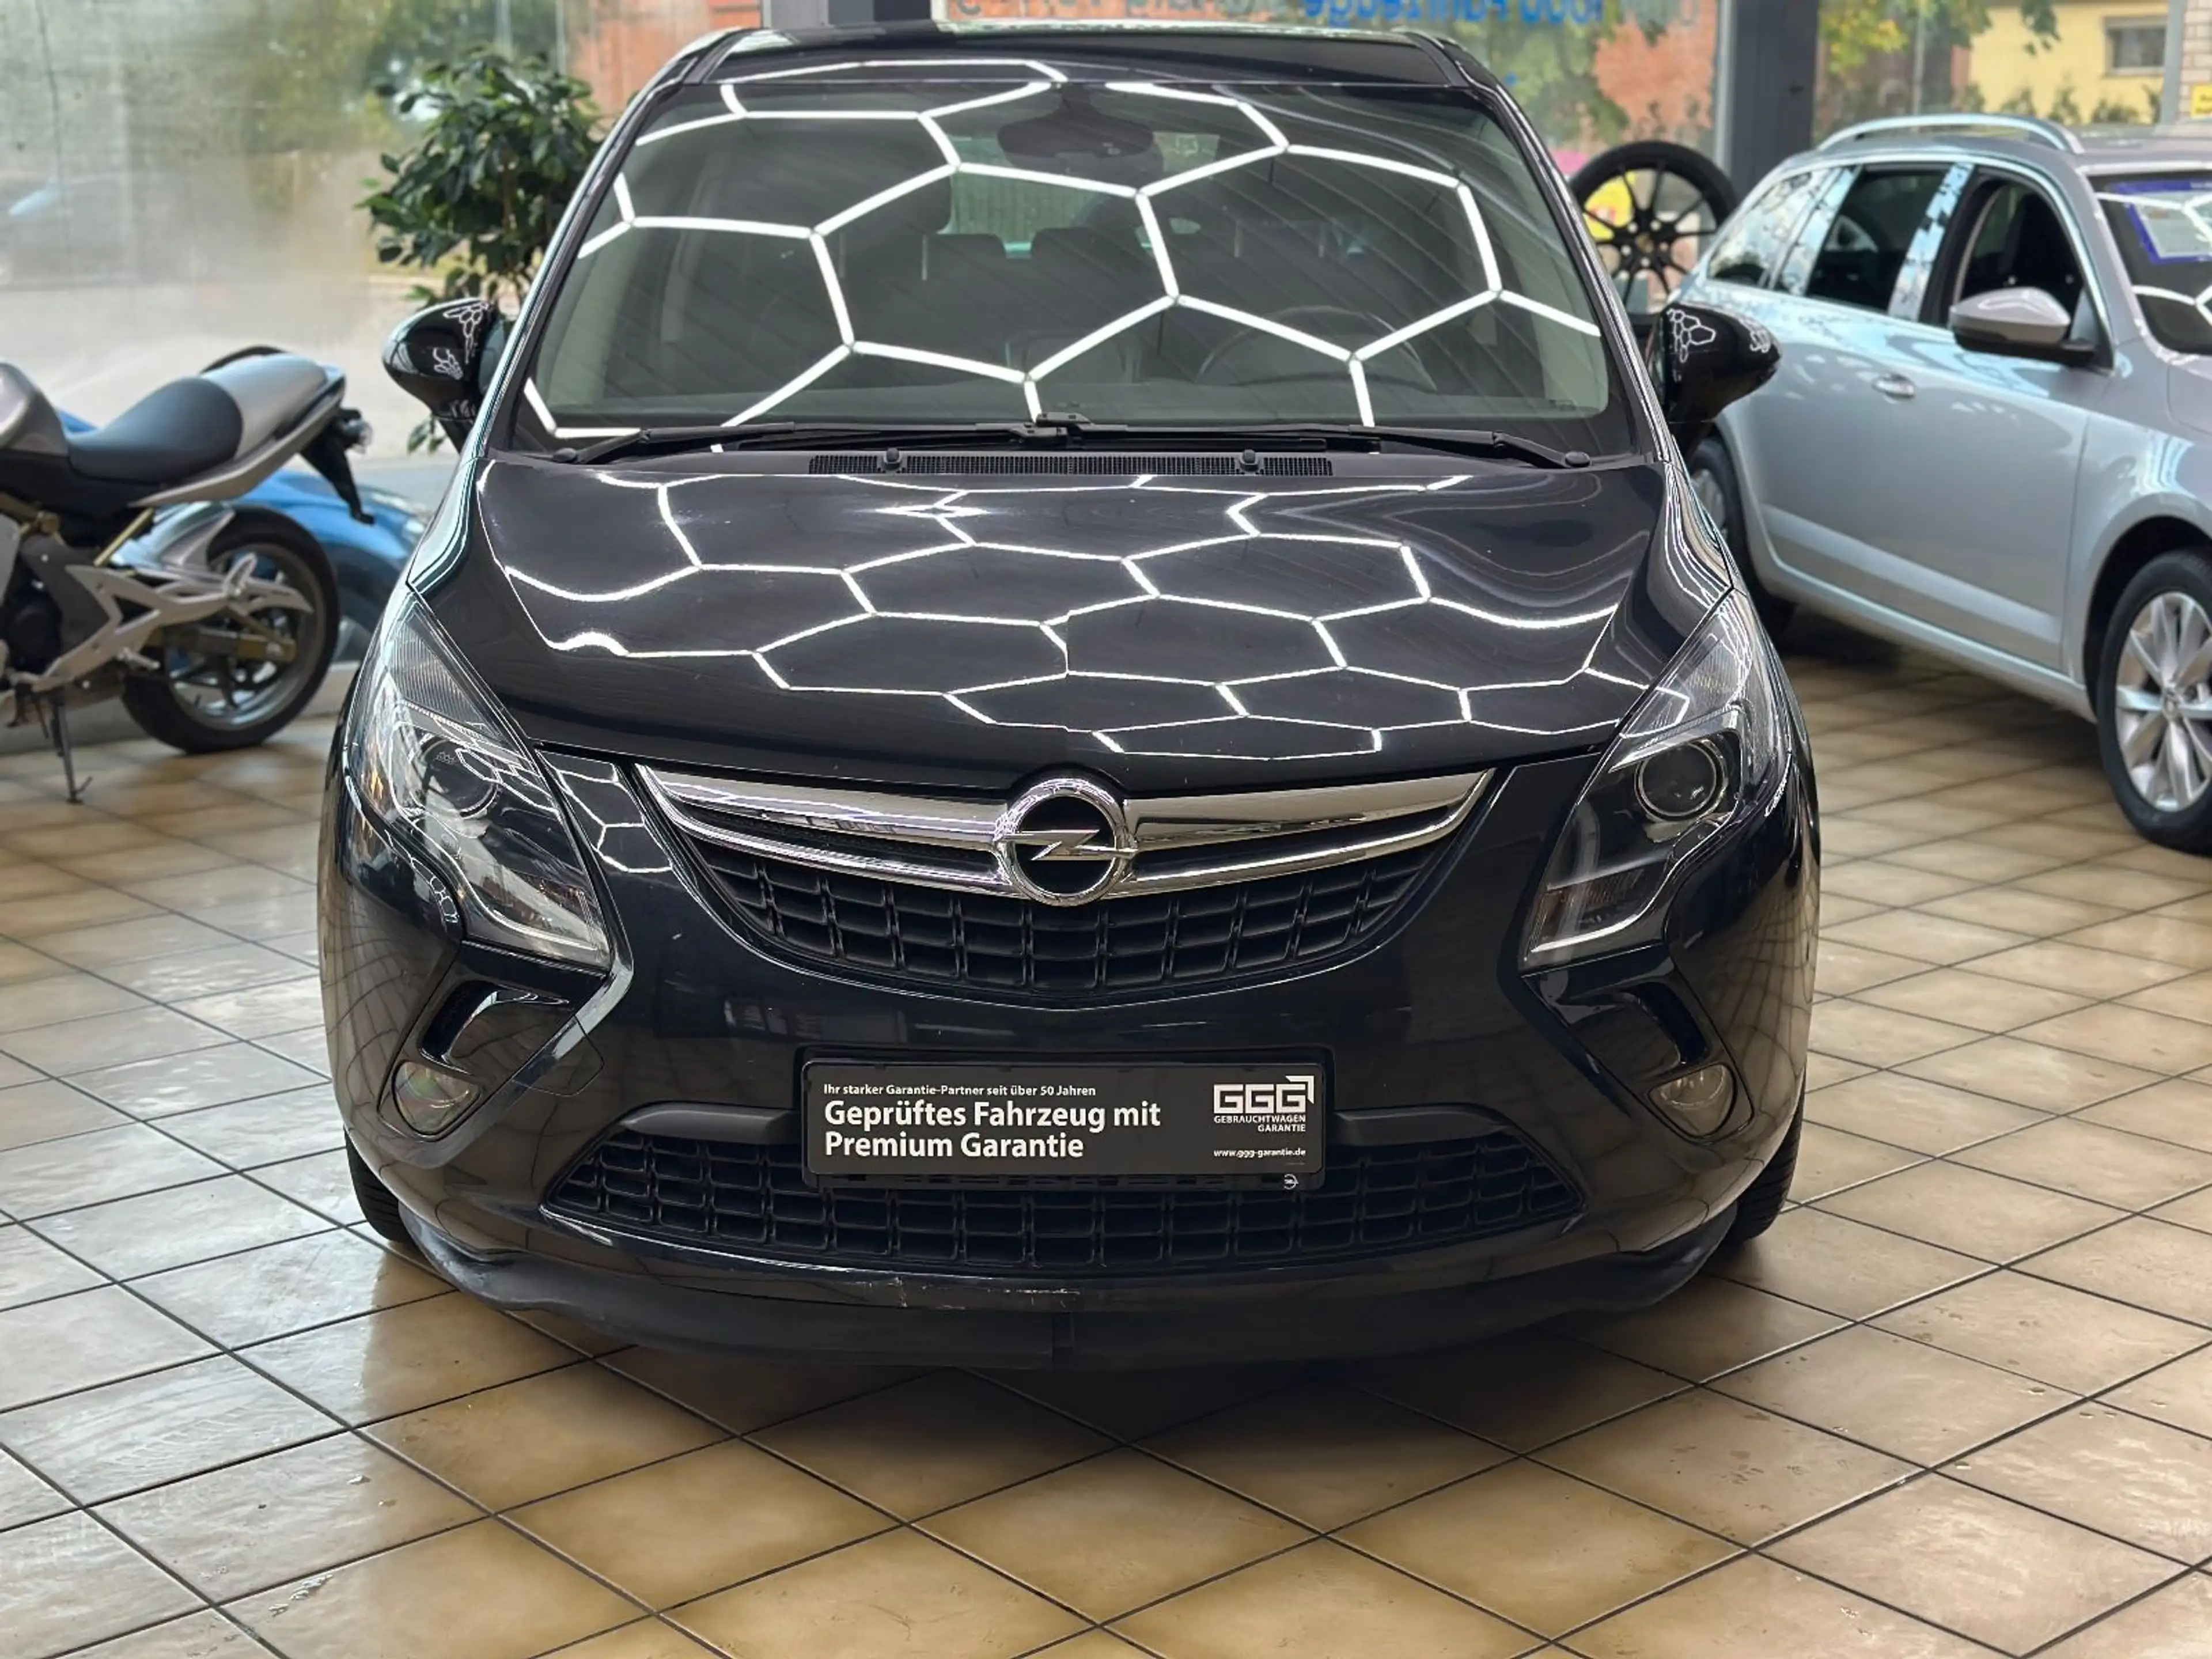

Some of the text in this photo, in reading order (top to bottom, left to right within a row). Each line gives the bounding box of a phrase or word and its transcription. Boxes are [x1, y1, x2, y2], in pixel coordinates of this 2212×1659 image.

[824, 1084, 1096, 1096] Ihr starker Garantie-Partner seit über 50 Jahren
[1214, 1083, 1306, 1113] GGG
[824, 1099, 1161, 1133] Geprüftes Fahrzeug mit
[1213, 1114, 1306, 1123] GEBRAUCHTWAGEN
[1257, 1123, 1306, 1132] GARANTIE
[825, 1131, 1084, 1158] Premium Garantie
[1213, 1147, 1306, 1158] www.ggg-garantie.de
